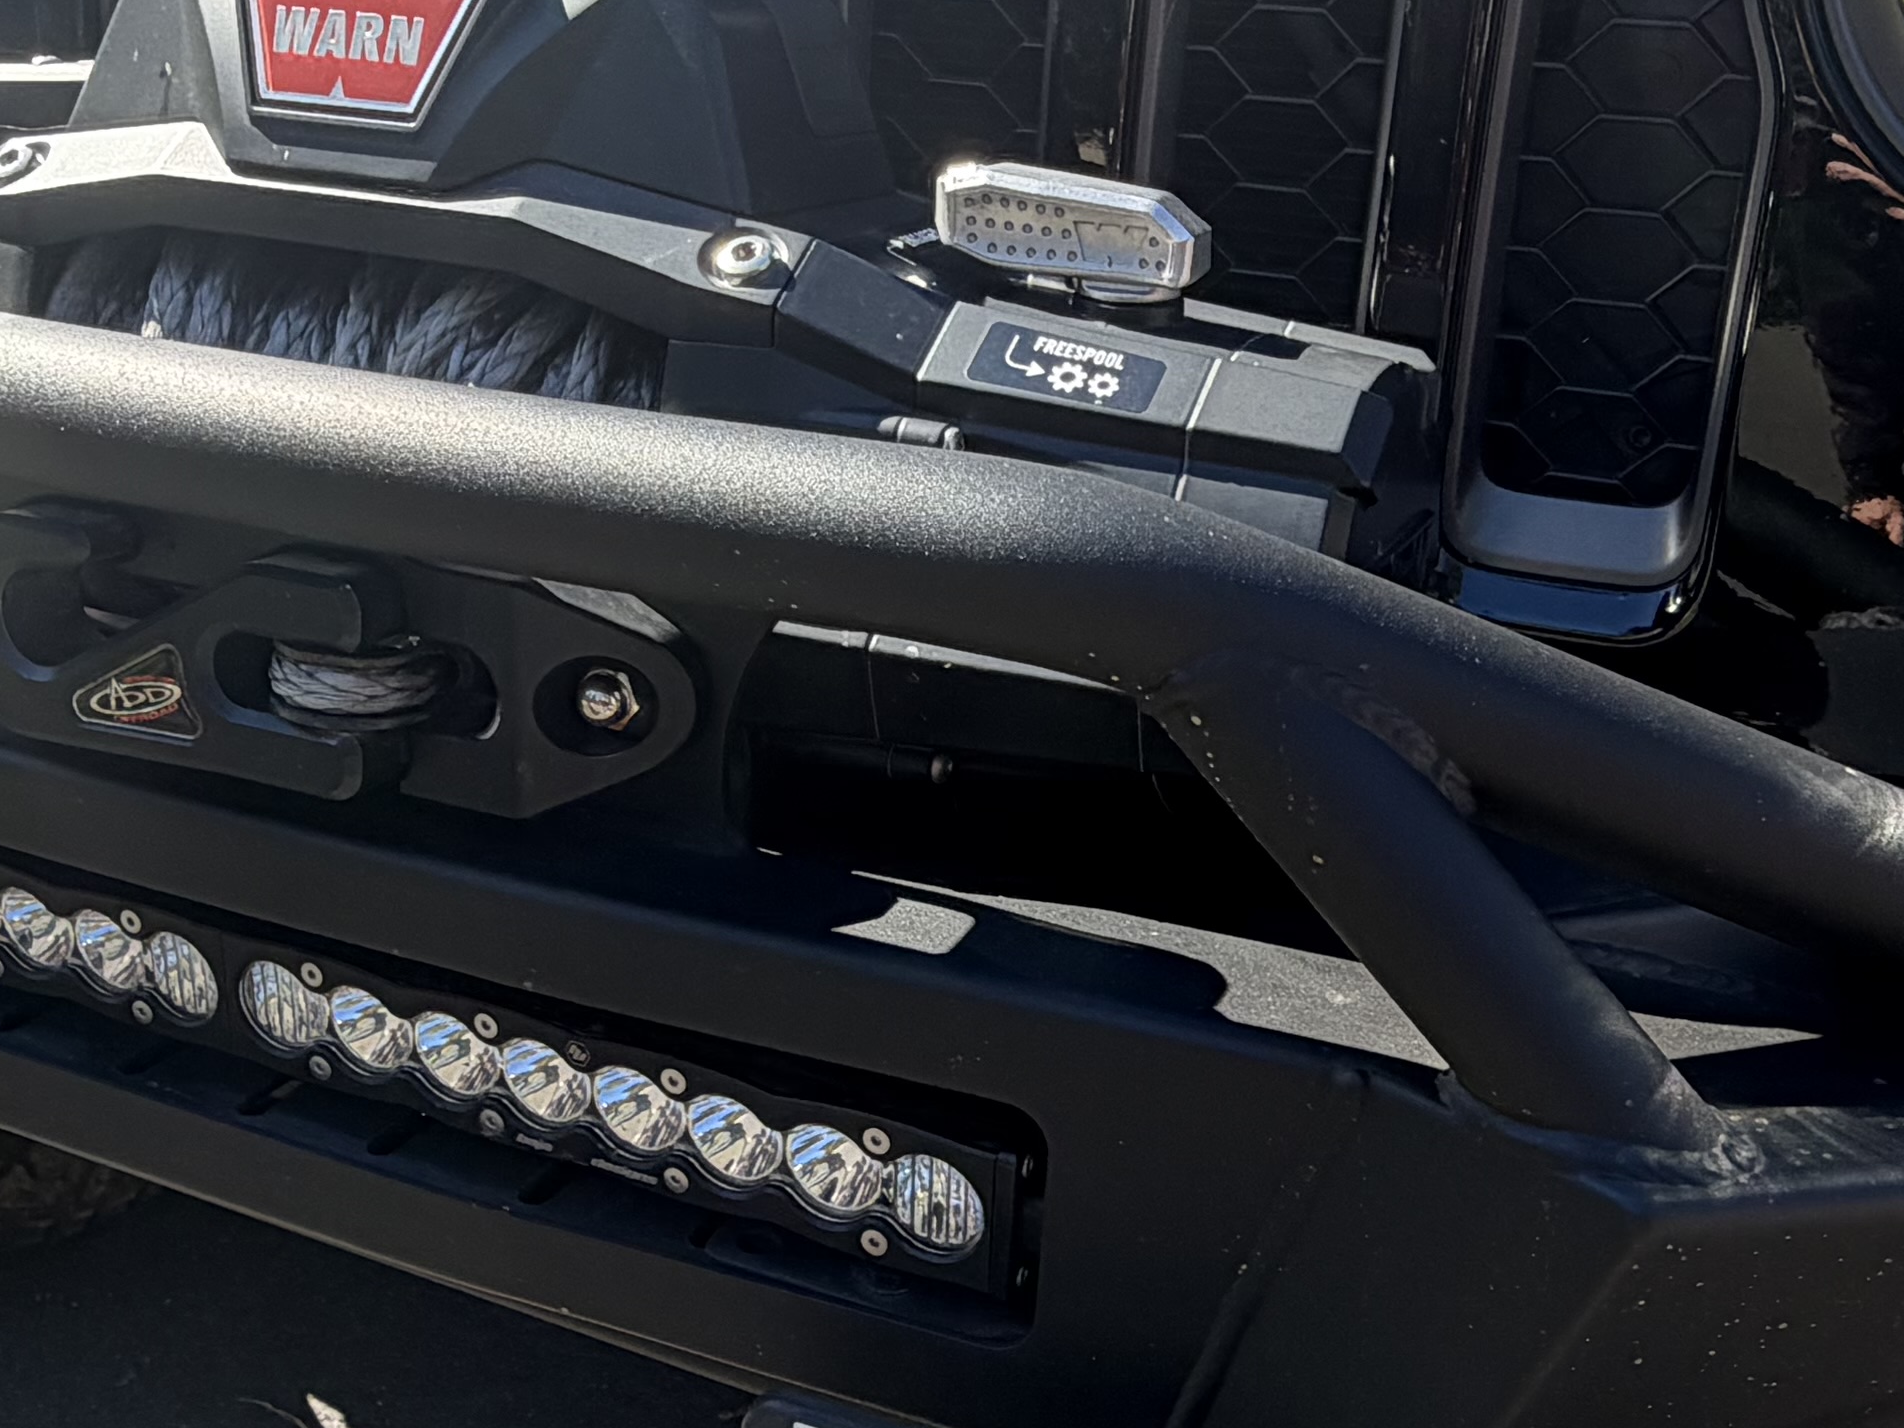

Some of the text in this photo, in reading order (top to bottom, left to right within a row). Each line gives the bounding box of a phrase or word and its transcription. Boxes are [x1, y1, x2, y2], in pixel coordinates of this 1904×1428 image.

[273, 4, 424, 66] WARN
[1033, 335, 1124, 371] FREESPOOL
[110, 677, 172, 710] ADD
